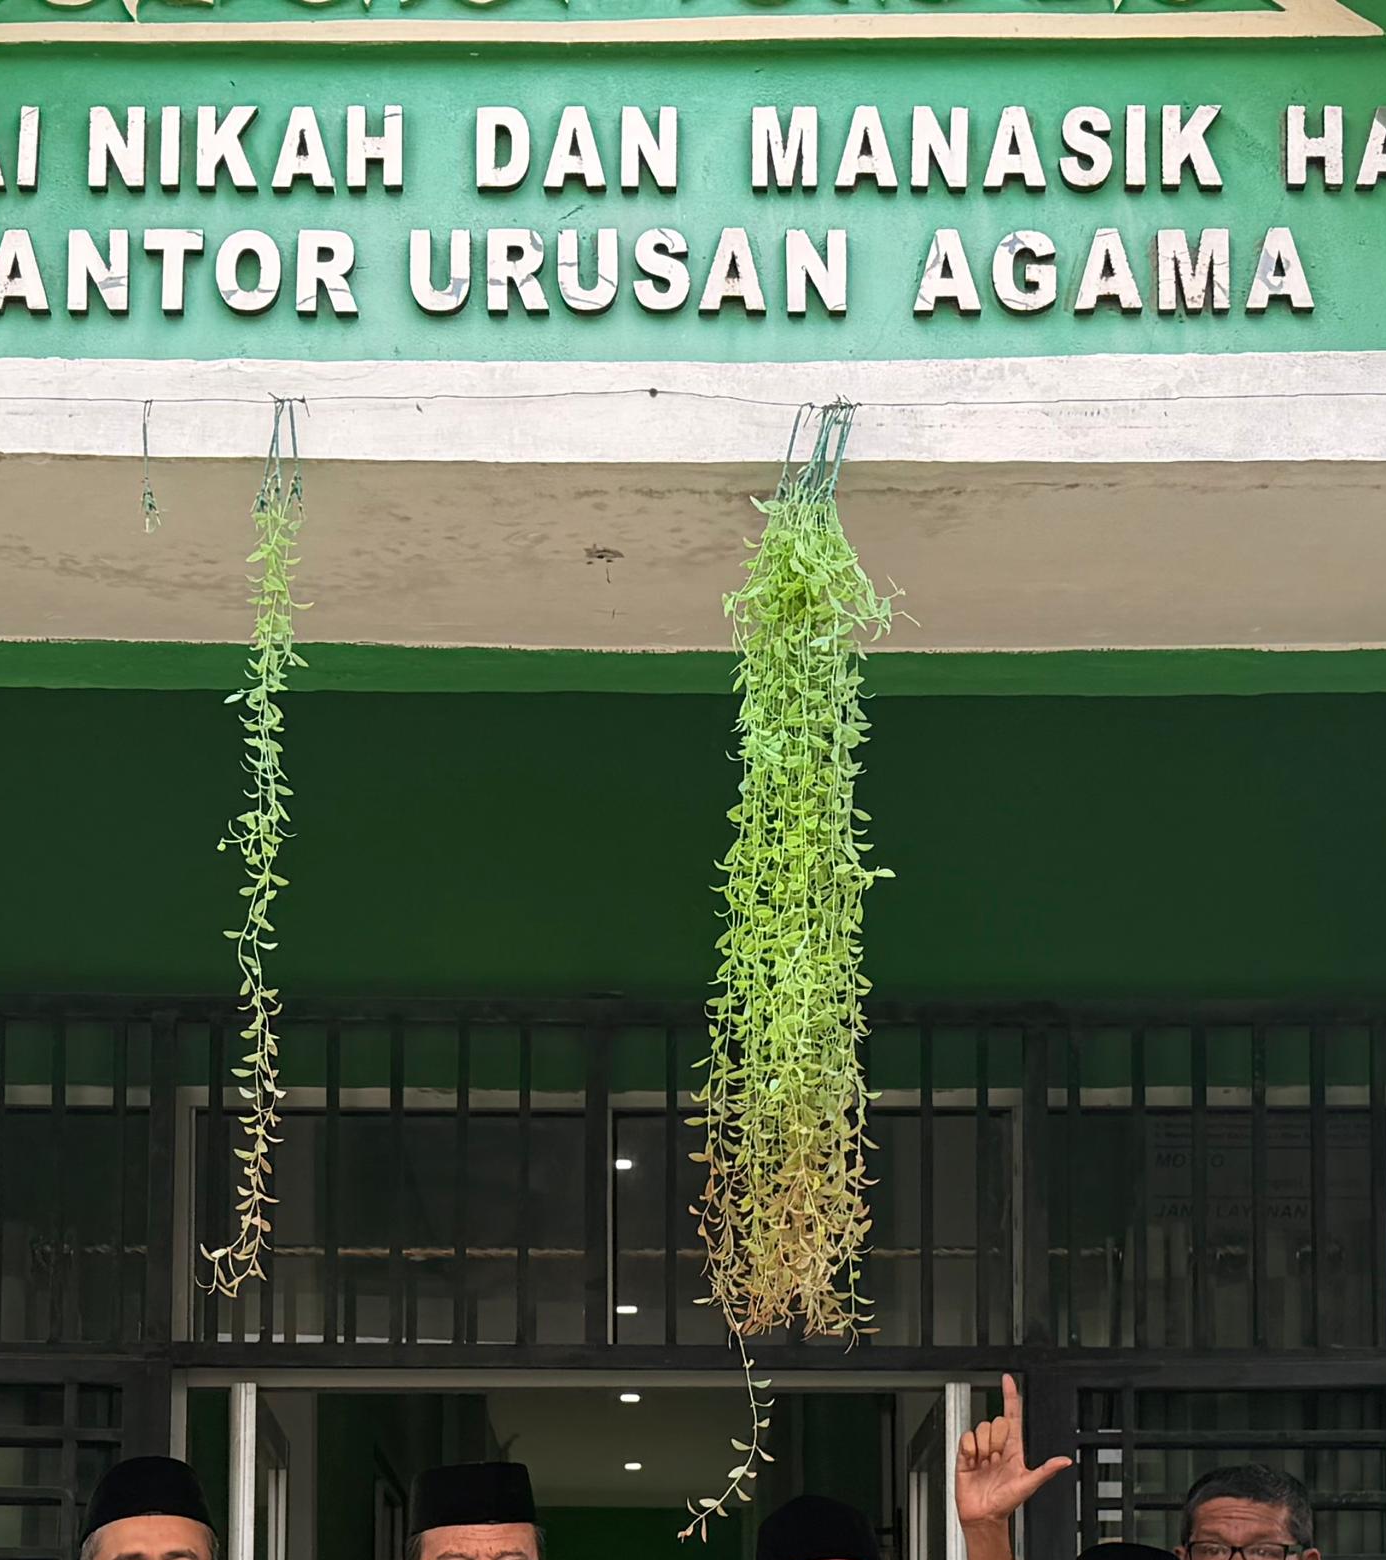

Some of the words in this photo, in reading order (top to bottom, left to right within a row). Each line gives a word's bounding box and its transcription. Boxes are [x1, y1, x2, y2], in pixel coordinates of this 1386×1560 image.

[87, 104, 404, 192] NIKAH
[475, 105, 678, 194] DAN
[750, 104, 1224, 193] MANASIK
[409, 227, 848, 317] URUSAN
[912, 226, 1315, 317] AGAMA
